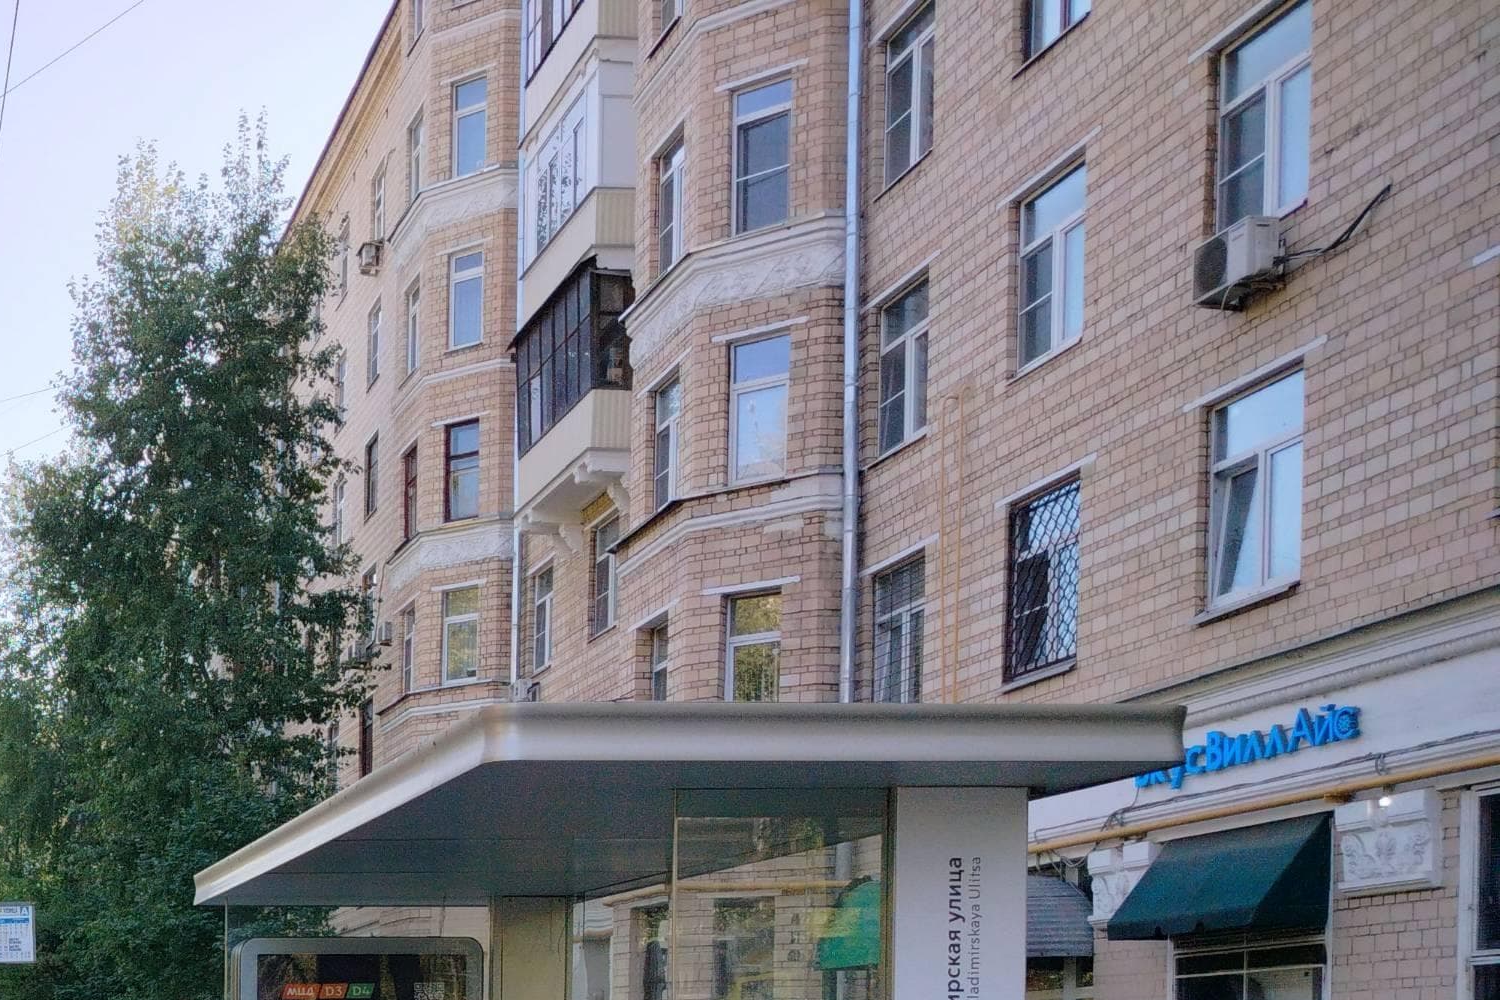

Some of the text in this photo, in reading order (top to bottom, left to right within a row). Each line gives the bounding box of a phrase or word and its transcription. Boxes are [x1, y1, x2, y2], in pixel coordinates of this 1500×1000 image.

[948, 857, 965, 924] улица
[969, 857, 981, 899] Ulitsa
[325, 986, 343, 996] D3
[352, 986, 370, 996] D4
